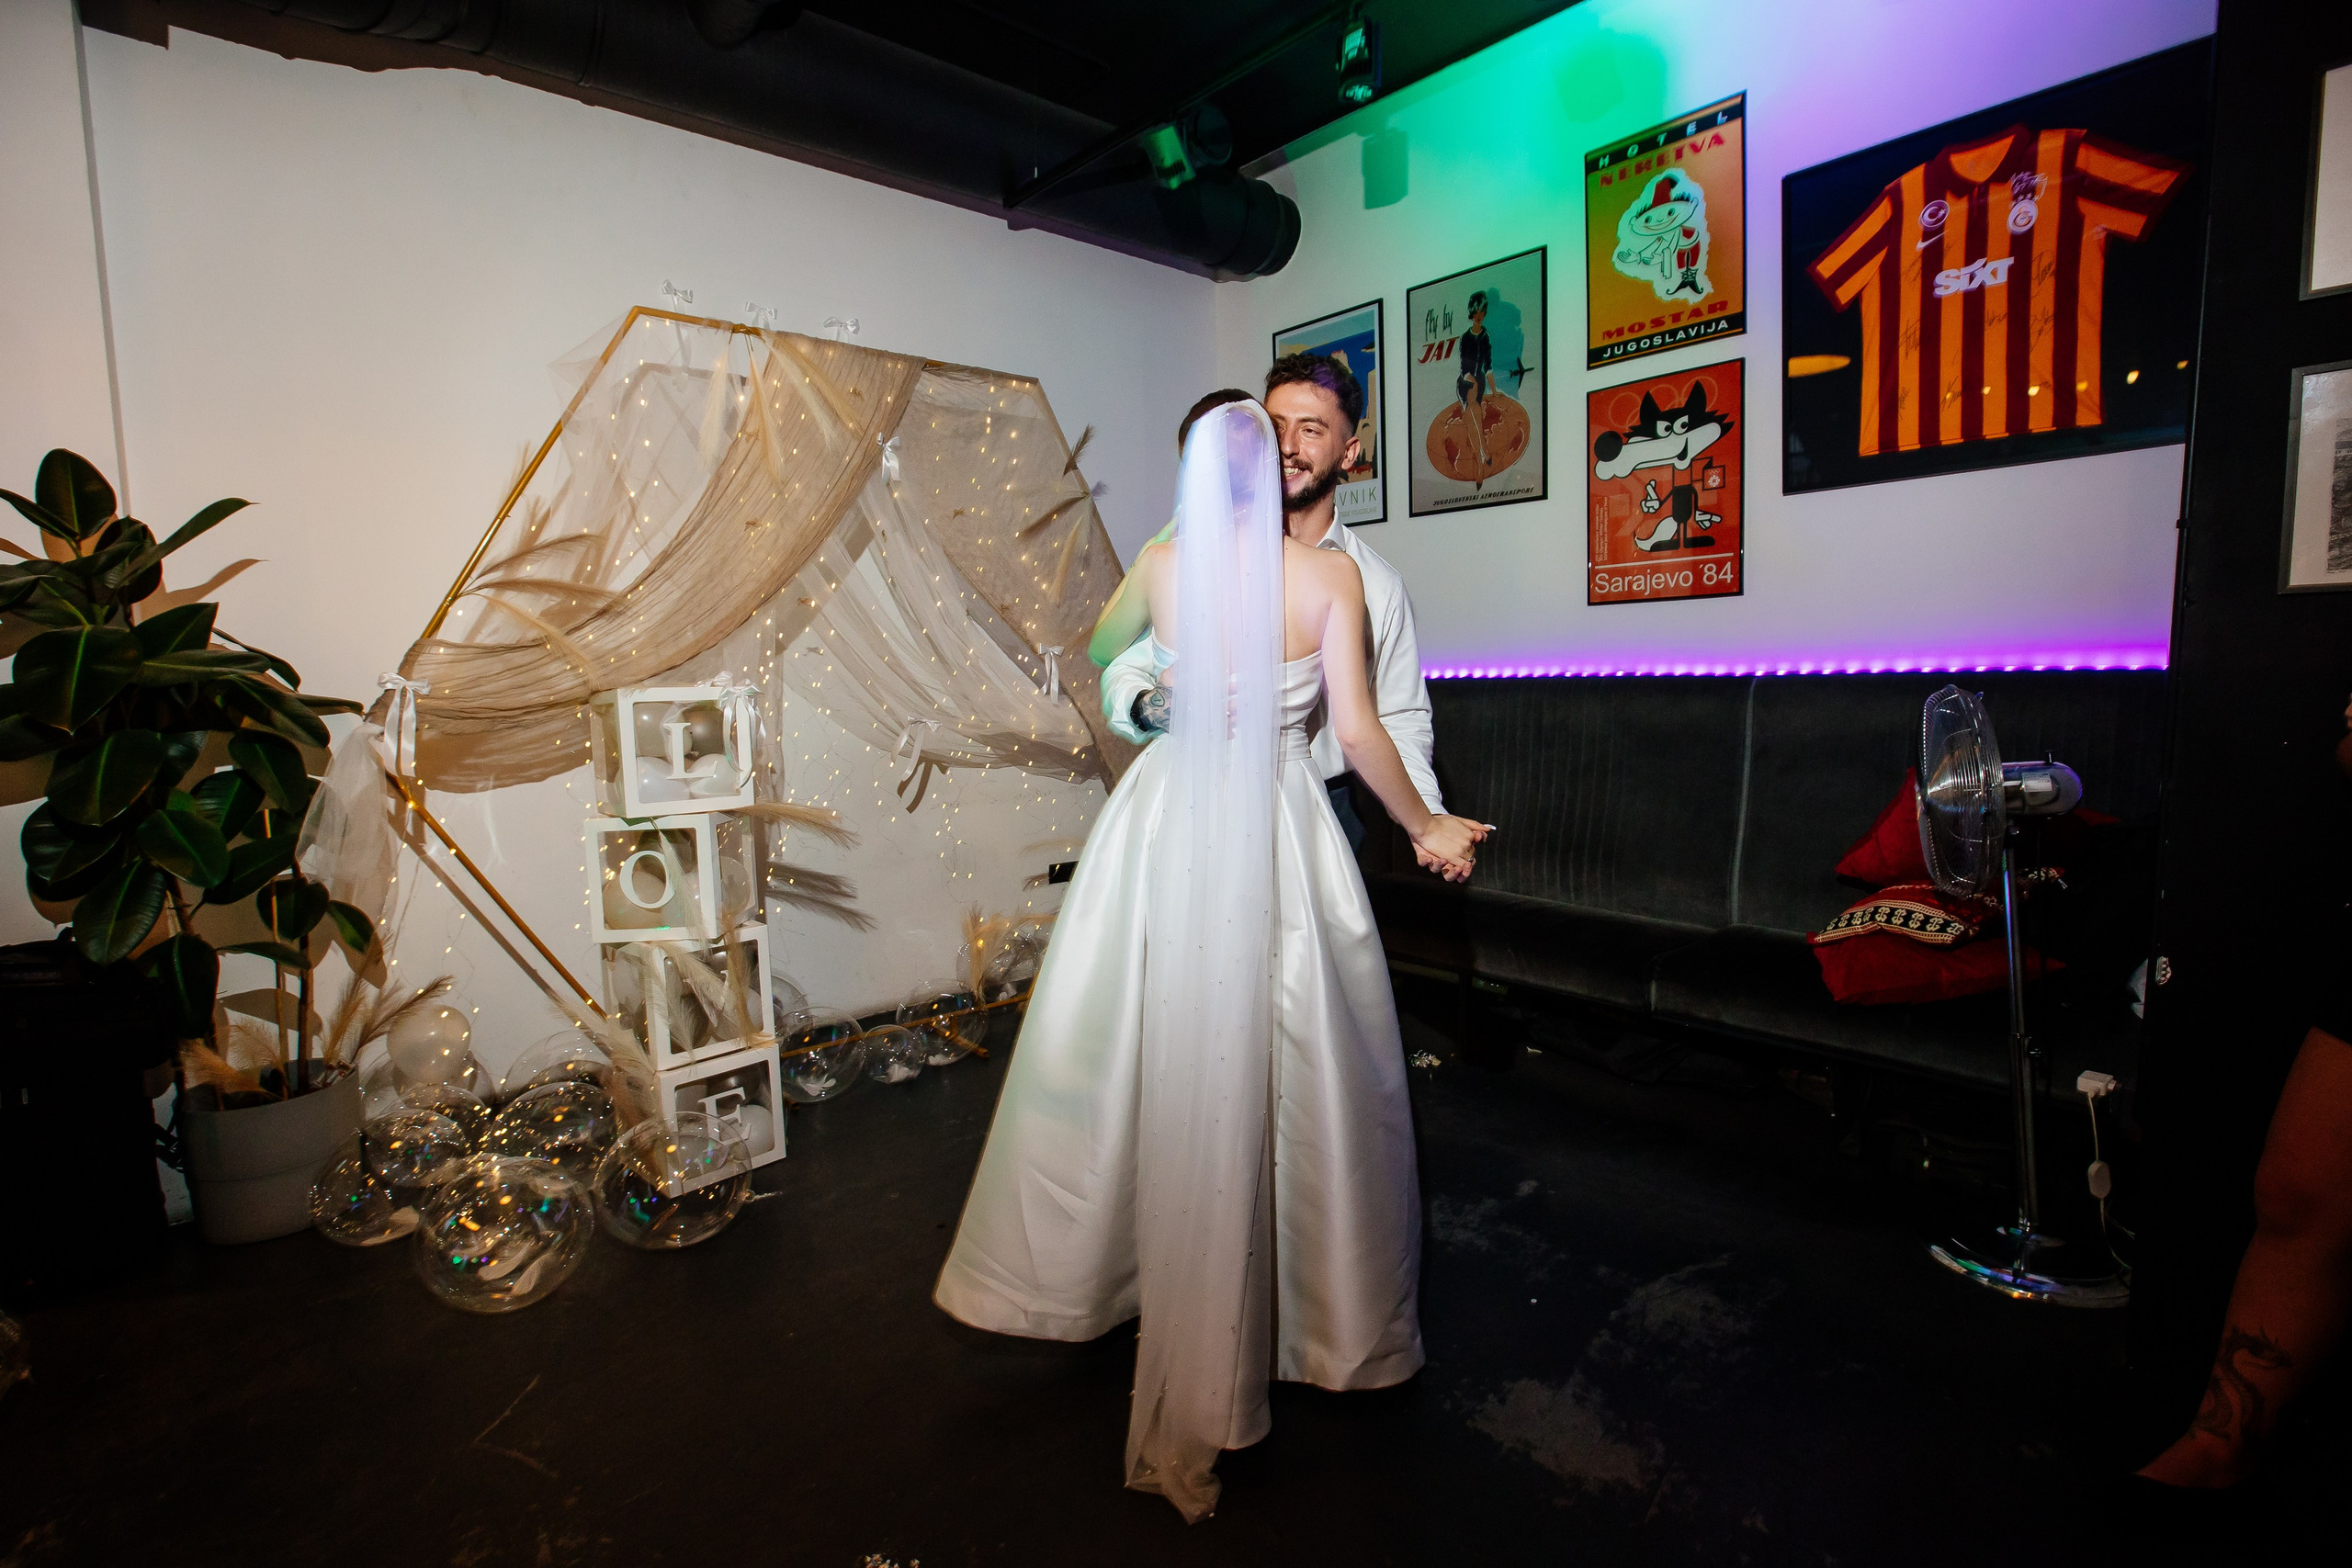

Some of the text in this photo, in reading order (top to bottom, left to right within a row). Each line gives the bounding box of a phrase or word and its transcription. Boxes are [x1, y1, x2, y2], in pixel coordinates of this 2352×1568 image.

[1599, 111, 1728, 170] HOTEL
[1442, 303, 1453, 335] by
[1602, 299, 1728, 341] MOSTAR
[1418, 336, 1461, 364] JAT
[1602, 320, 1729, 357] JUGOSLAVIJA
[1335, 486, 1377, 506] VNIK
[1595, 561, 1734, 595] Sarajevo '84
